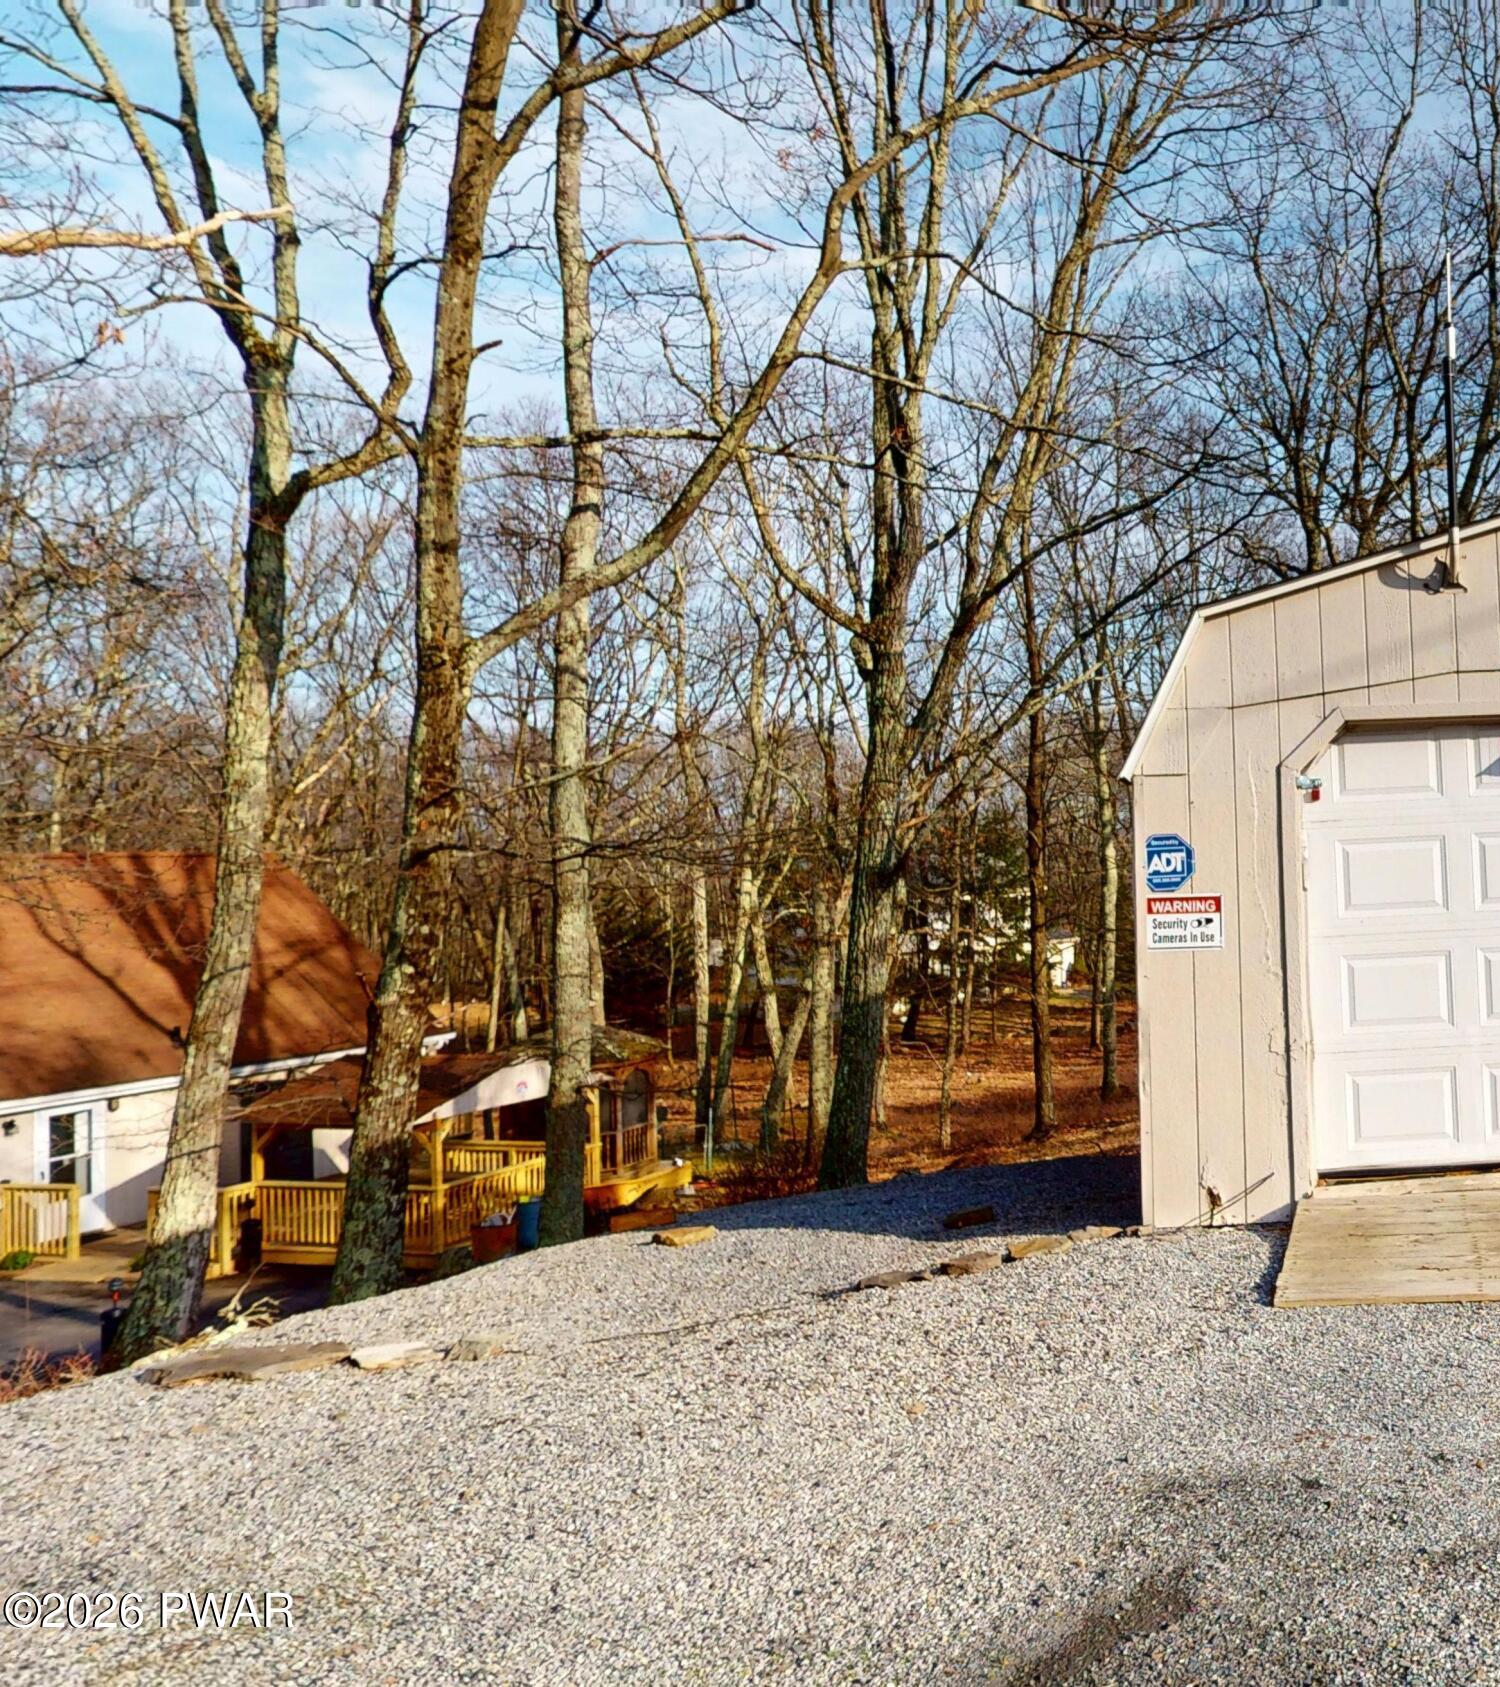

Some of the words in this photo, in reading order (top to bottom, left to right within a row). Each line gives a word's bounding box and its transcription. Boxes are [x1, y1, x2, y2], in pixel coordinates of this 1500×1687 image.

[1148, 852, 1185, 873] ADT
[1150, 900, 1216, 912] WARNING
[1152, 918, 1188, 930] Security
[1152, 933, 1187, 943] Cameras
[1190, 932, 1198, 942] In
[1200, 932, 1215, 942] Use
